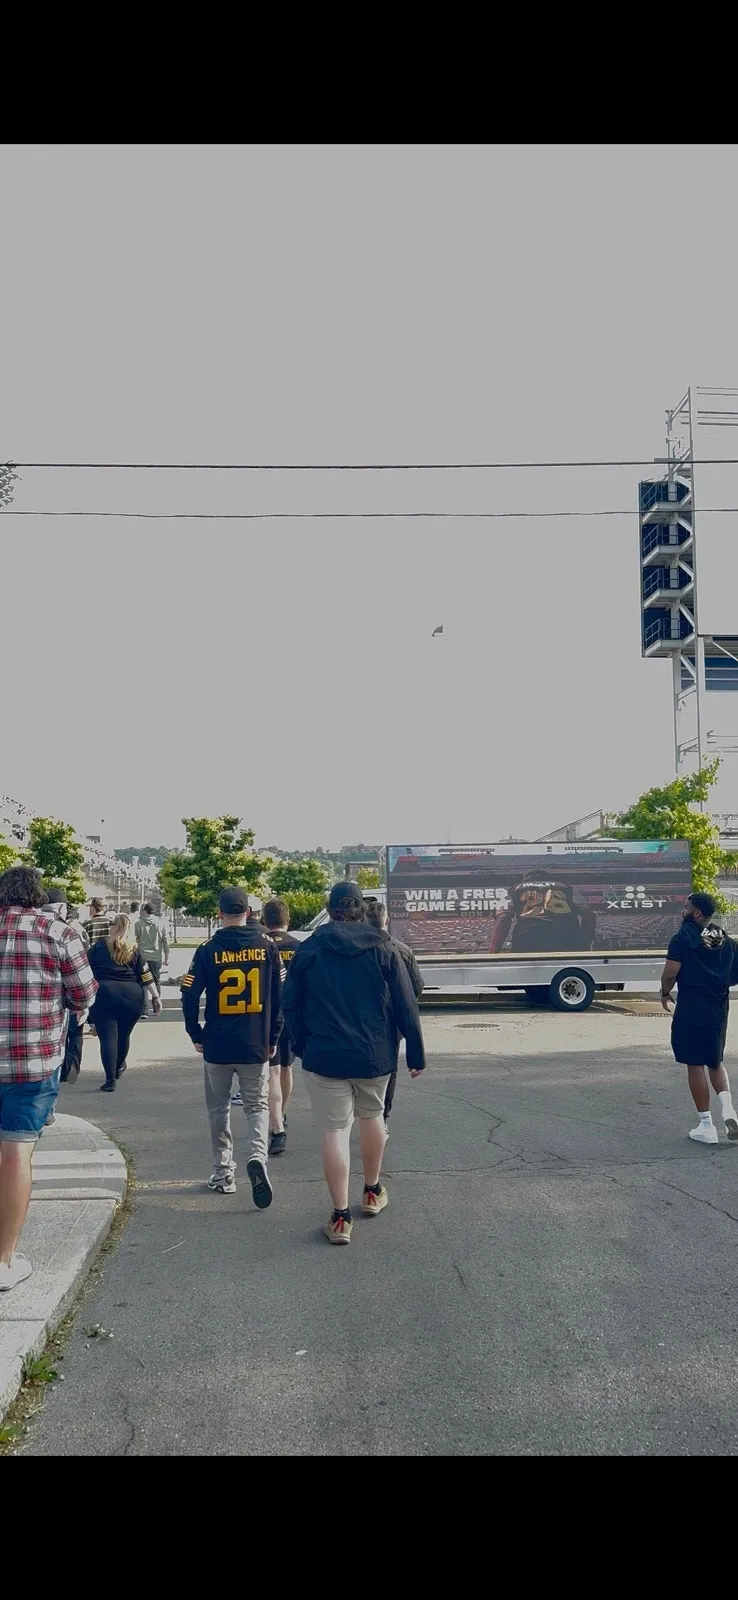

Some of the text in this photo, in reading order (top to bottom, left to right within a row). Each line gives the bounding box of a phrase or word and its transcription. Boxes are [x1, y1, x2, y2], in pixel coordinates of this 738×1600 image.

[404, 889, 442, 901] WIN
[446, 889, 458, 900] A
[405, 900, 455, 912] GAME
[459, 899, 511, 911] SHIRT
[606, 899, 667, 909] XEIST
[215, 949, 266, 963] LAWRENCE
[219, 968, 262, 1014] 21
